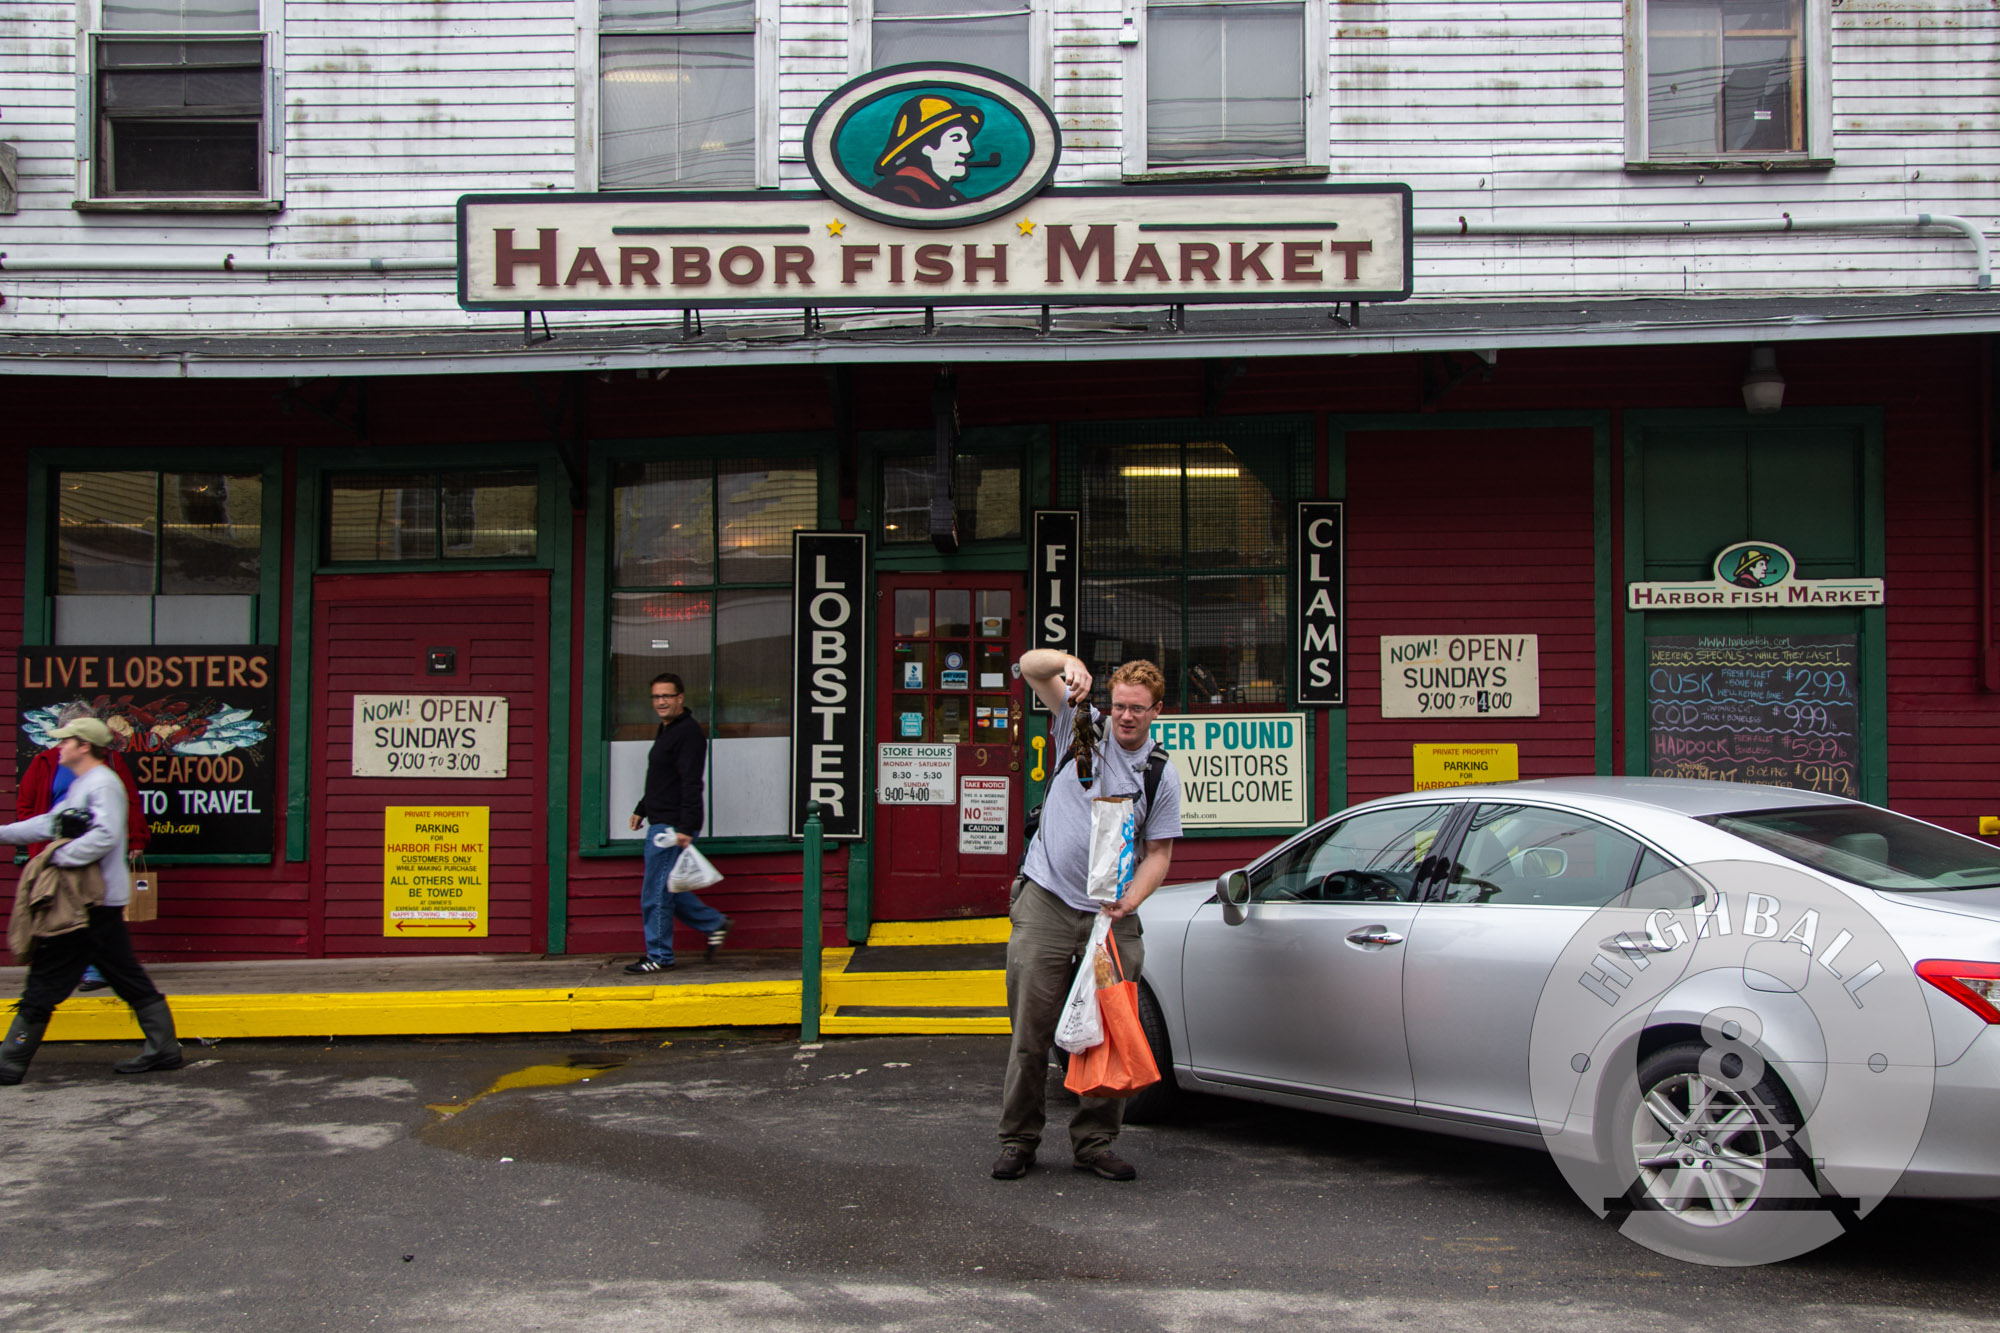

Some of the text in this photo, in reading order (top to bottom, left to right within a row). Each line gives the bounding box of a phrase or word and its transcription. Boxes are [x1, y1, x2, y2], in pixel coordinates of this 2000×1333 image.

[492, 224, 1373, 287] HARBOR FISH MARKET
[1044, 544, 1068, 655] FIS
[1304, 518, 1338, 688] CLAMS
[1634, 586, 1880, 605] HARBOR FISH MARKET
[1391, 638, 1525, 664] NOW! OPEN!
[1652, 650, 1693, 660] WEEKEND
[1696, 650, 1745, 661] SPECIALS
[1755, 651, 1779, 660] WHILE
[24, 656, 269, 688] LIVE LOBSTERS
[1403, 666, 1507, 689] SUNDAYS
[809, 555, 851, 817] LOBSTER
[1650, 668, 1713, 698] CUSK
[363, 698, 496, 723] NOW! OPEN!
[1418, 692, 1455, 713] 9:00
[1652, 704, 1699, 725] COD
[126, 731, 162, 753] AND
[375, 727, 476, 748] SUNDAYS
[1205, 721, 1294, 750] POUND
[1654, 734, 1730, 757] HADDOCK
[387, 752, 425, 772] 9:00
[447, 753, 480, 770] 3:00
[882, 747, 953, 757] STORE HOURS
[976, 748, 987, 767] 9
[138, 755, 244, 783] SEAFOOD
[892, 771, 911, 779] 8:30
[923, 771, 942, 779] 5:30
[1188, 755, 1288, 777] VISITORS
[1444, 761, 1488, 771] PARKING
[138, 789, 261, 815] TO TRAVEL
[1184, 780, 1293, 803] WELCOME
[964, 807, 981, 820] NO
[415, 824, 460, 833] PARKING
[387, 843, 430, 853] HARBOR
[434, 843, 457, 853] FISH
[401, 855, 472, 863] CUSTOMERS ONLY
[390, 876, 482, 886] ALL OTHERS WILL
[408, 888, 463, 897] BE TOWED
